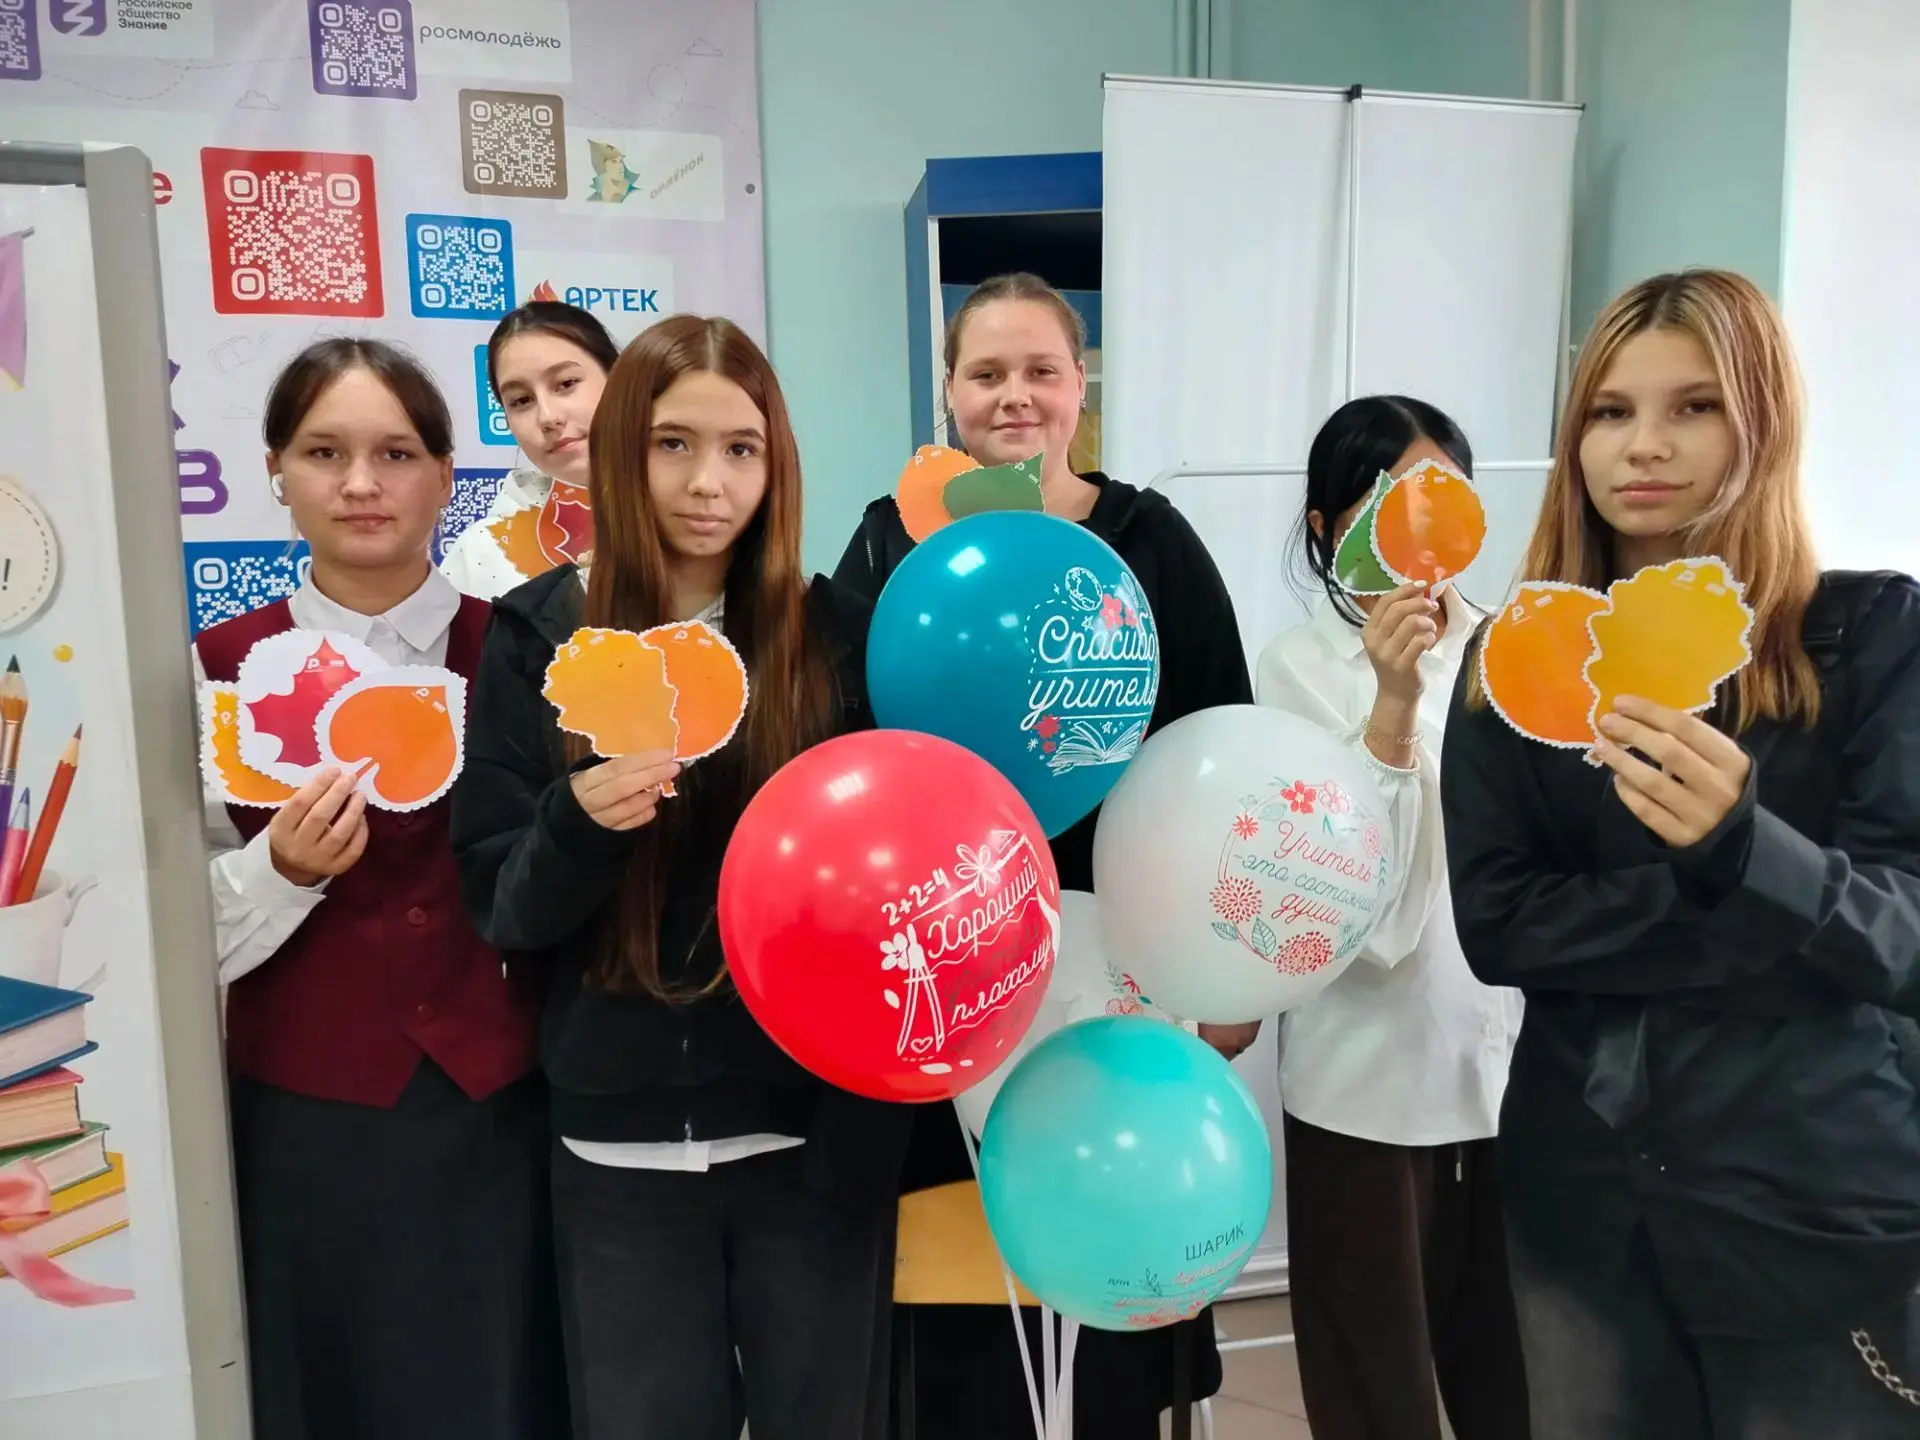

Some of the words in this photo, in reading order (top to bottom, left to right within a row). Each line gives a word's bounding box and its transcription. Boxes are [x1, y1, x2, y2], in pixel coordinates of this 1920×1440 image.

[118, 8, 181, 20] общество
[118, 18, 168, 30] Знание
[419, 25, 562, 49] росмолодёжь
[565, 286, 659, 312] АРТЕК
[1273, 820, 1372, 883] Учитель
[881, 867, 951, 927] 2+2=4
[927, 856, 1038, 959] Хороший
[1271, 893, 1341, 925] души
[1185, 1221, 1245, 1262] ШАРИК
